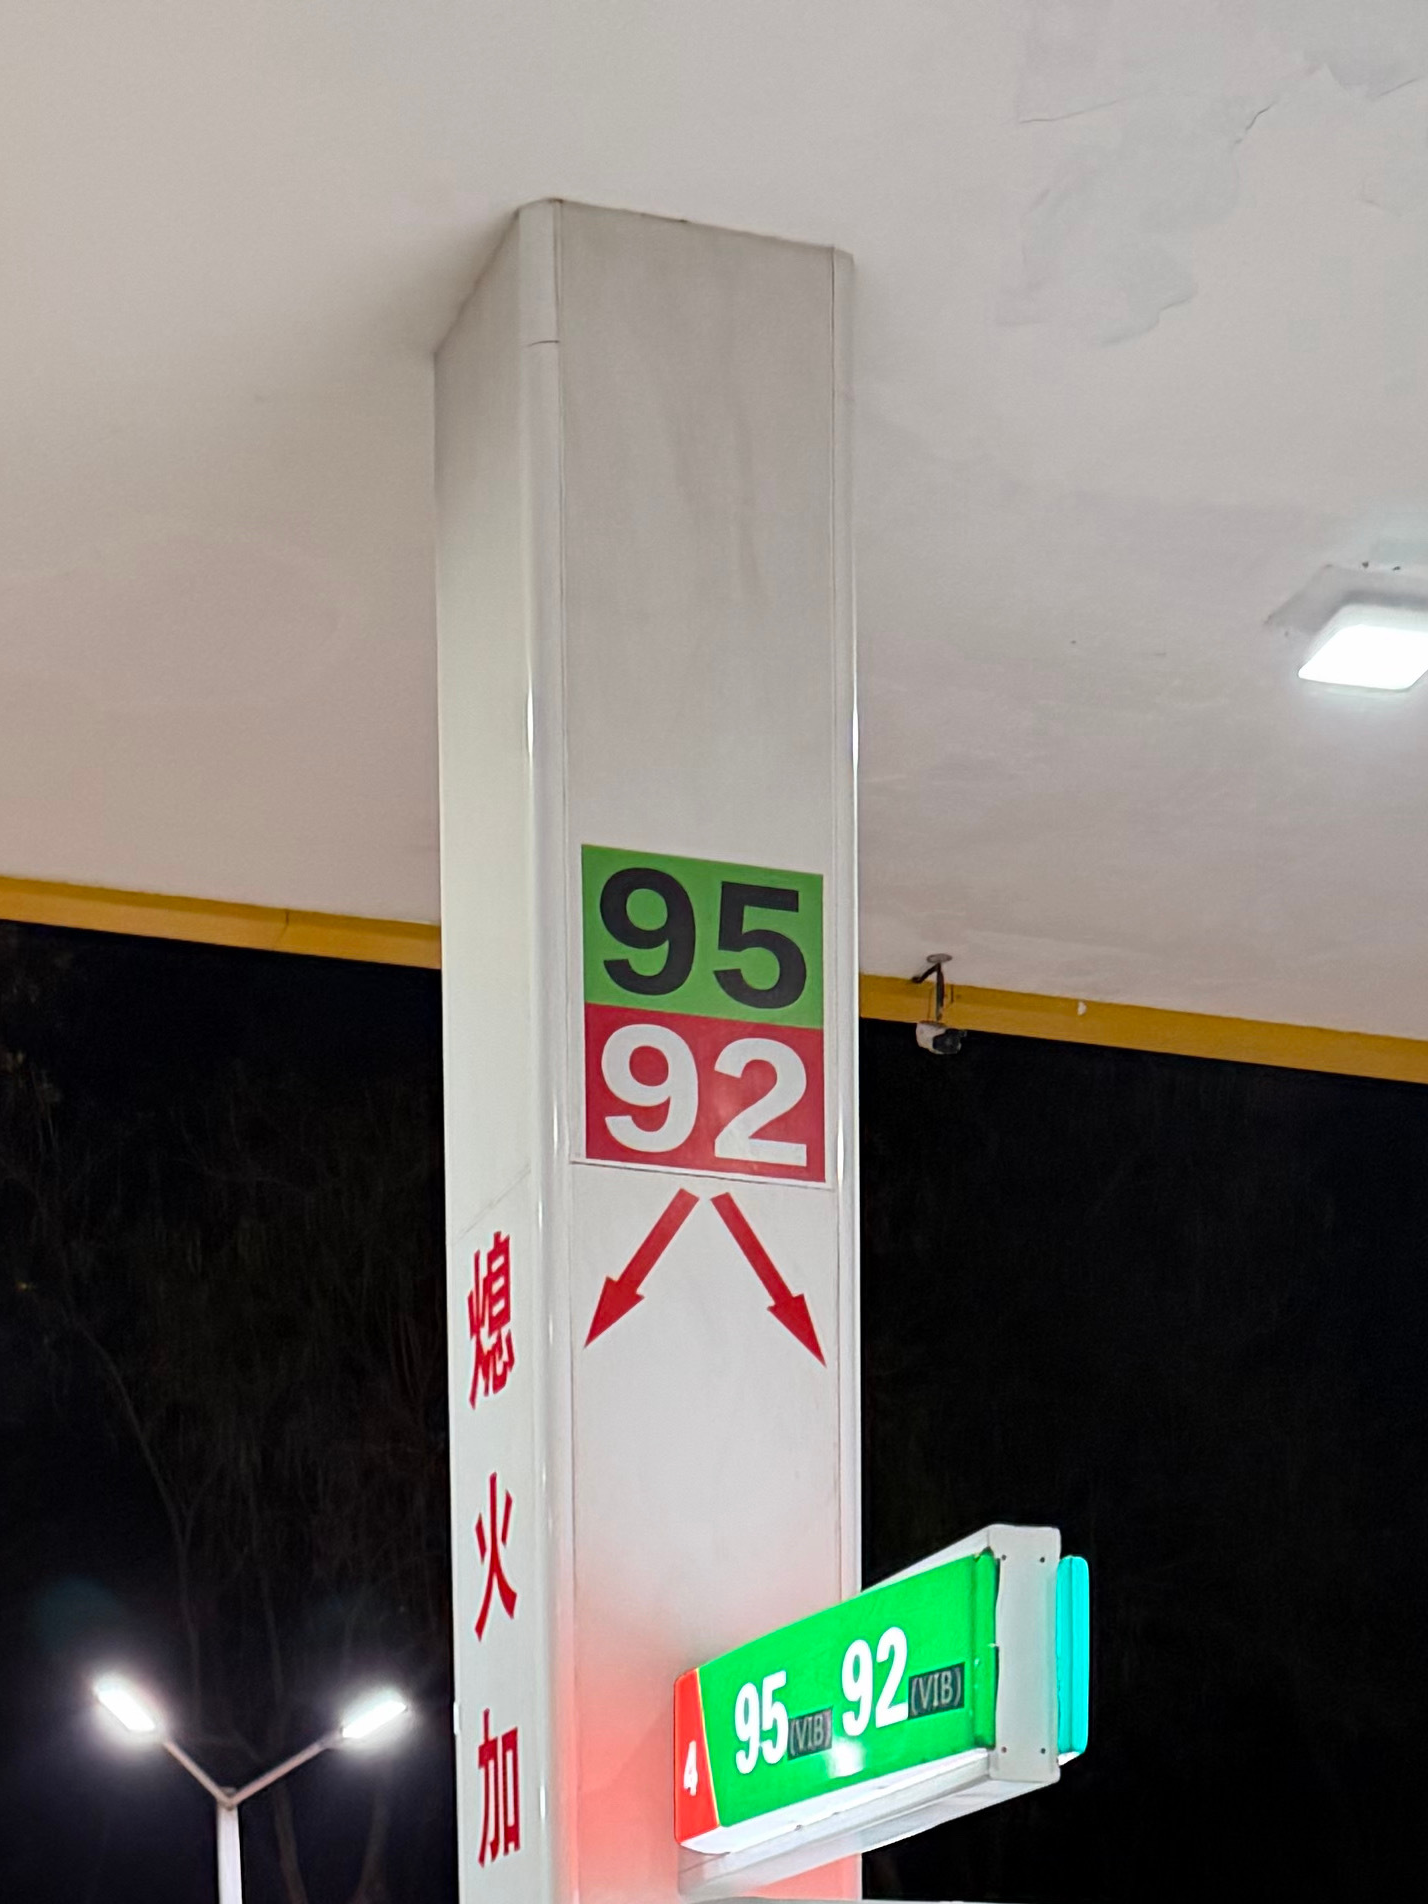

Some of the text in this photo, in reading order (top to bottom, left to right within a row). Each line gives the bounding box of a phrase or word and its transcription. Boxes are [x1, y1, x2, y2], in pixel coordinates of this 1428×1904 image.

[599, 867, 807, 1010] 95
[601, 1023, 807, 1168] 92
[683, 1740, 699, 1796] 4
[734, 1670, 789, 1774] 95
[841, 1626, 909, 1736] 92
